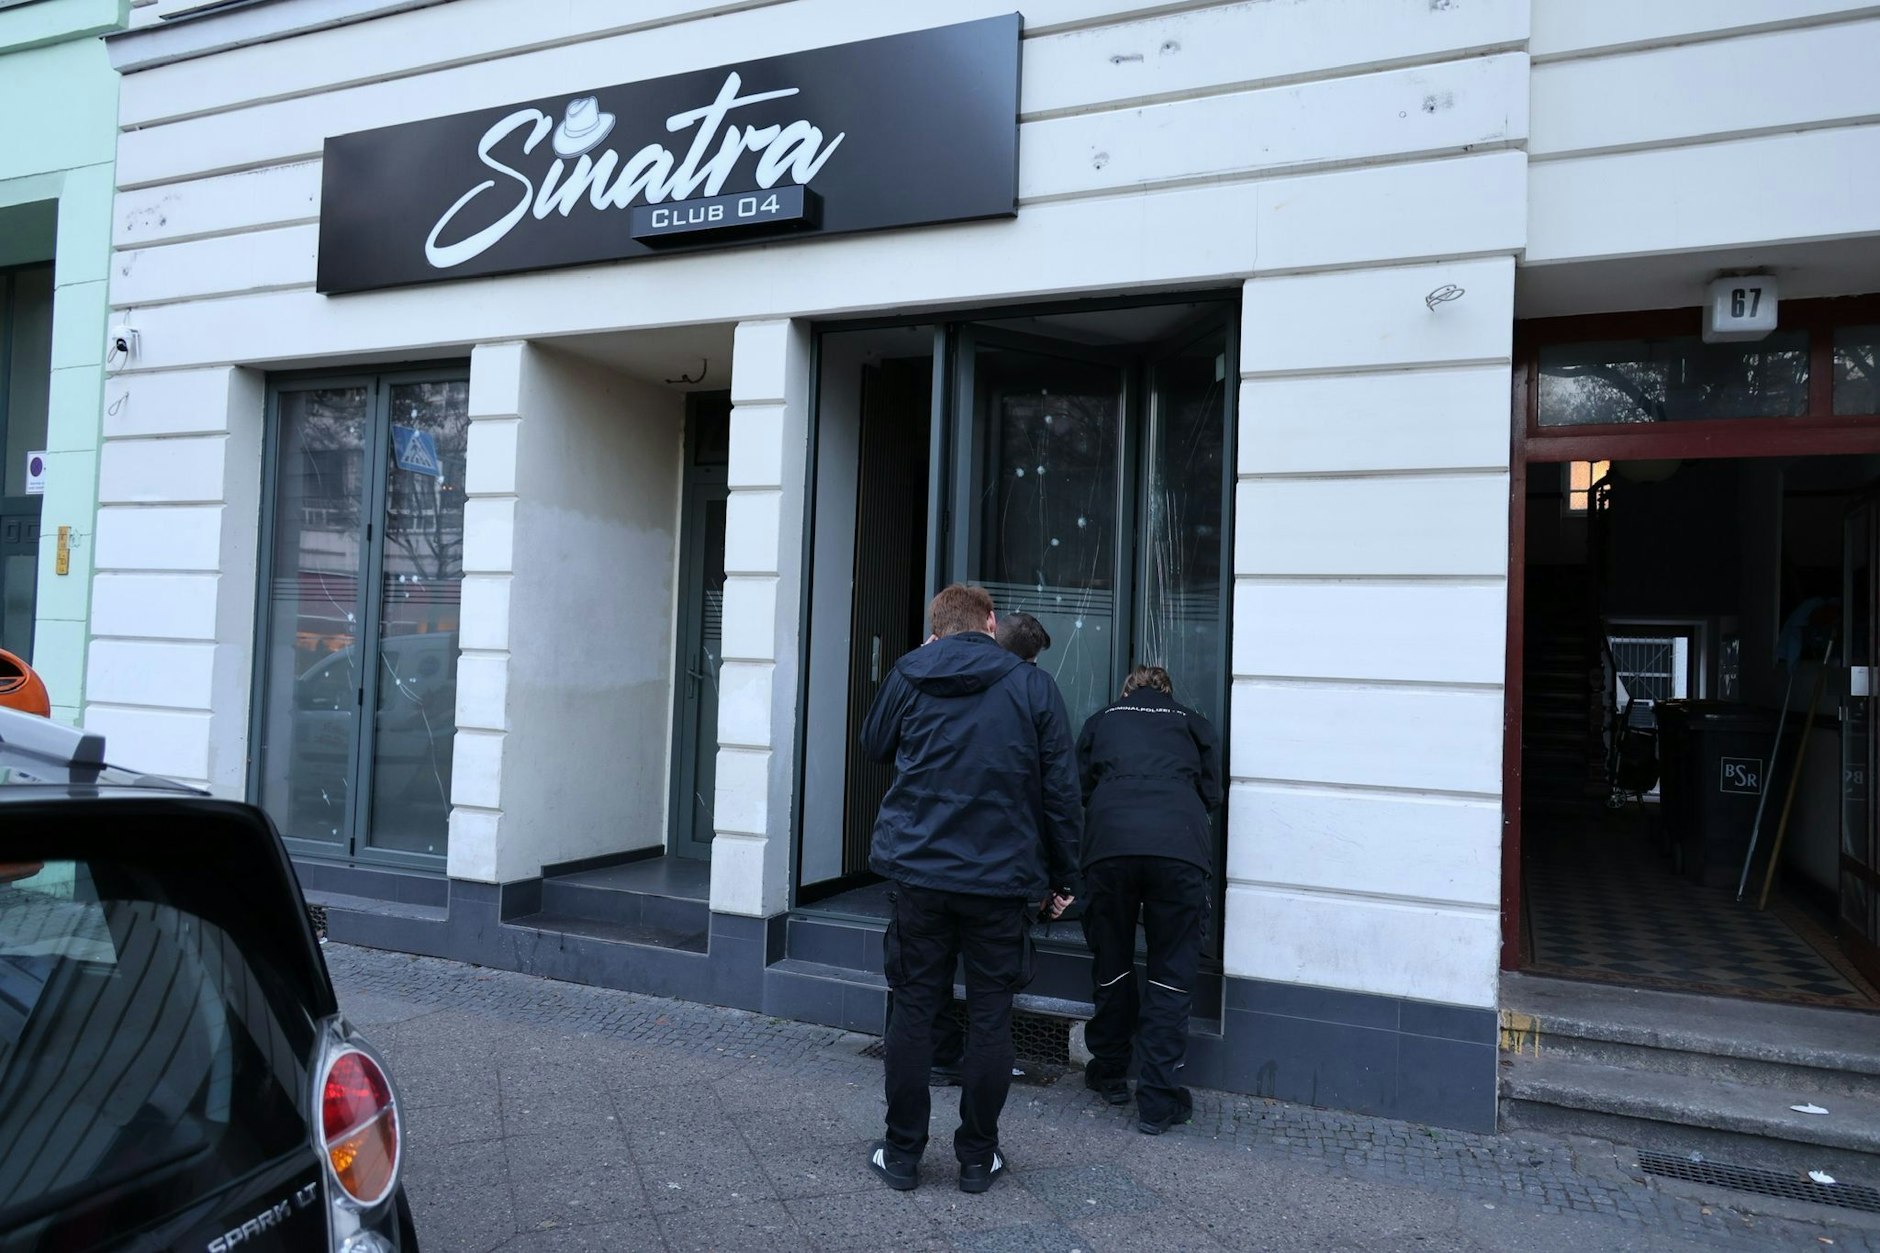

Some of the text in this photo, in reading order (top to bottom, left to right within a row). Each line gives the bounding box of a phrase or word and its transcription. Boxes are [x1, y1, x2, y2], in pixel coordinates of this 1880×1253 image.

[425, 71, 846, 268] Sinatra
[651, 193, 781, 228] CLUB 04
[1731, 288, 1762, 318] 67
[1724, 763, 1758, 788] BSR
[207, 1181, 317, 1253] SPARK LT
